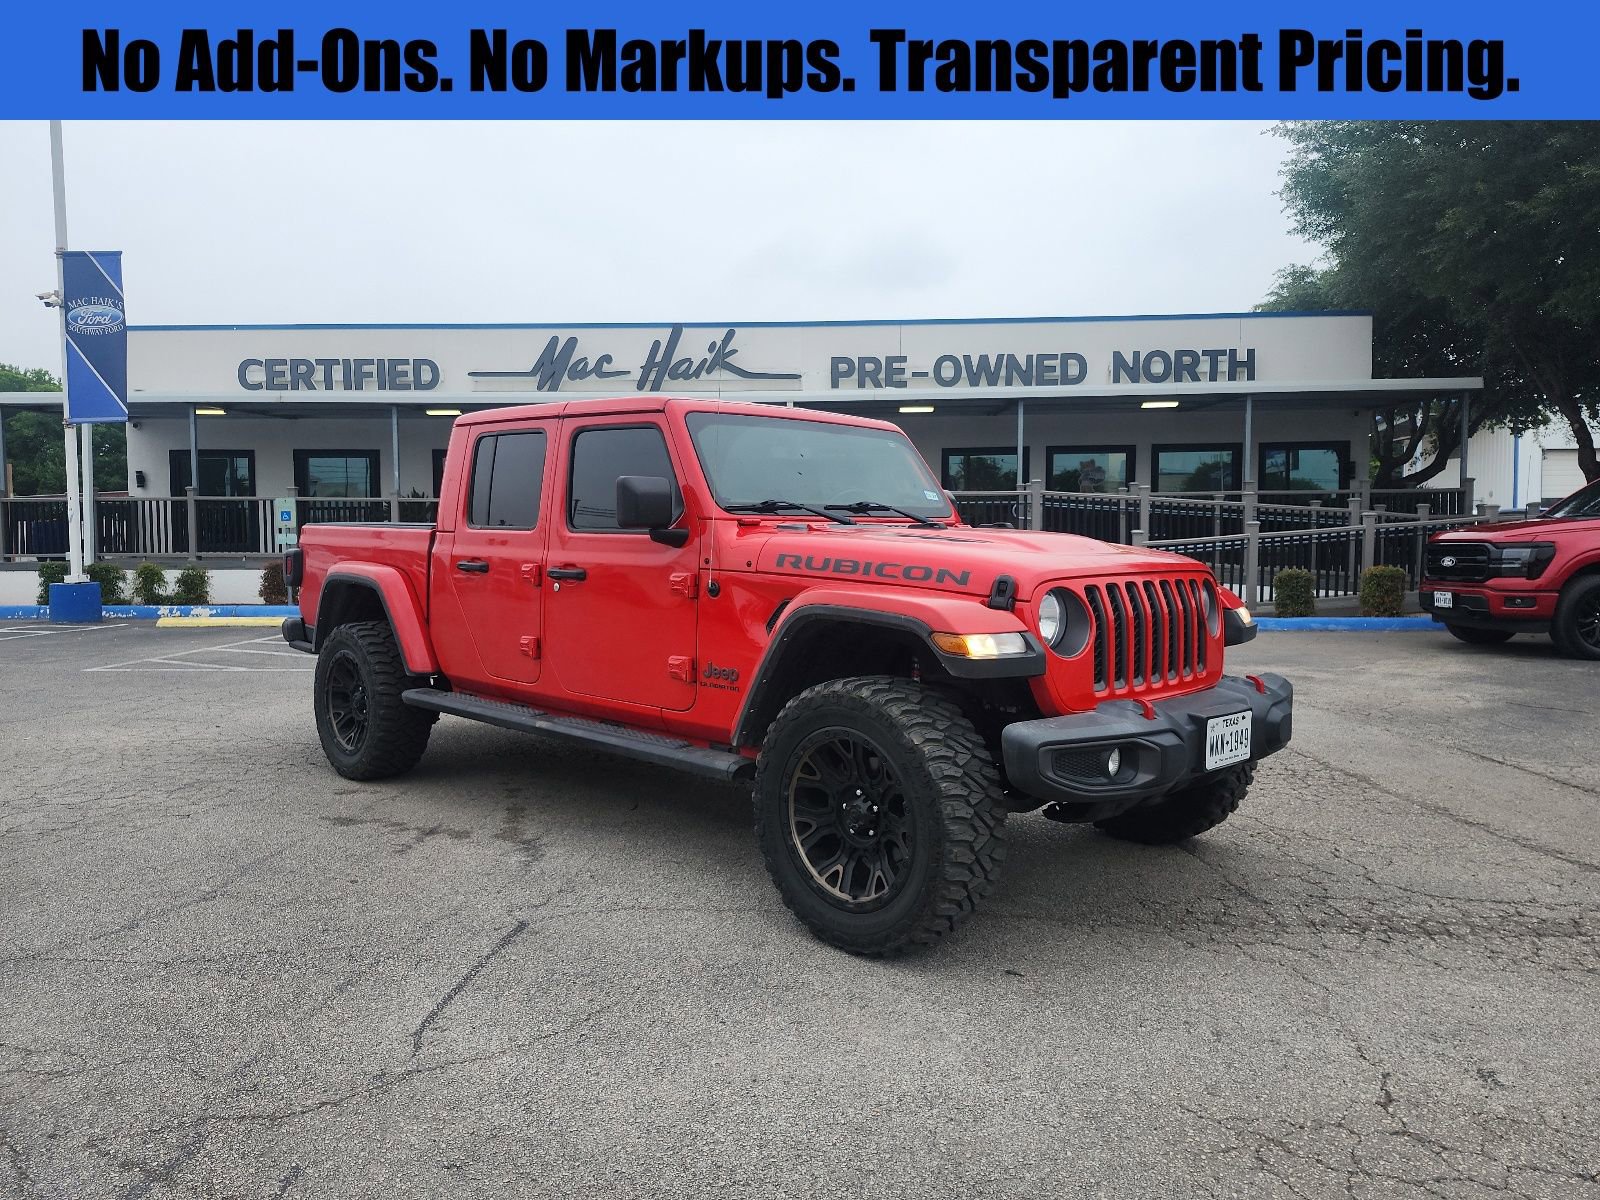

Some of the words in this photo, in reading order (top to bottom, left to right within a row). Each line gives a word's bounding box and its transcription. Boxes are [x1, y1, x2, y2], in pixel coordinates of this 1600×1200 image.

[67, 297, 89, 310] MAC
[91, 296, 124, 310] HAIK'S
[77, 308, 112, 325] Ford
[105, 323, 124, 335] FORD
[528, 335, 632, 392] Mac
[636, 324, 750, 392] Haik
[830, 352, 1088, 389] PRE-OWNED
[1112, 347, 1256, 384] NORTH
[237, 357, 440, 391] CERTIFIED
[775, 553, 971, 586] RUBICON
[703, 661, 739, 682] Jeep
[1222, 716, 1240, 728] TEXAS
